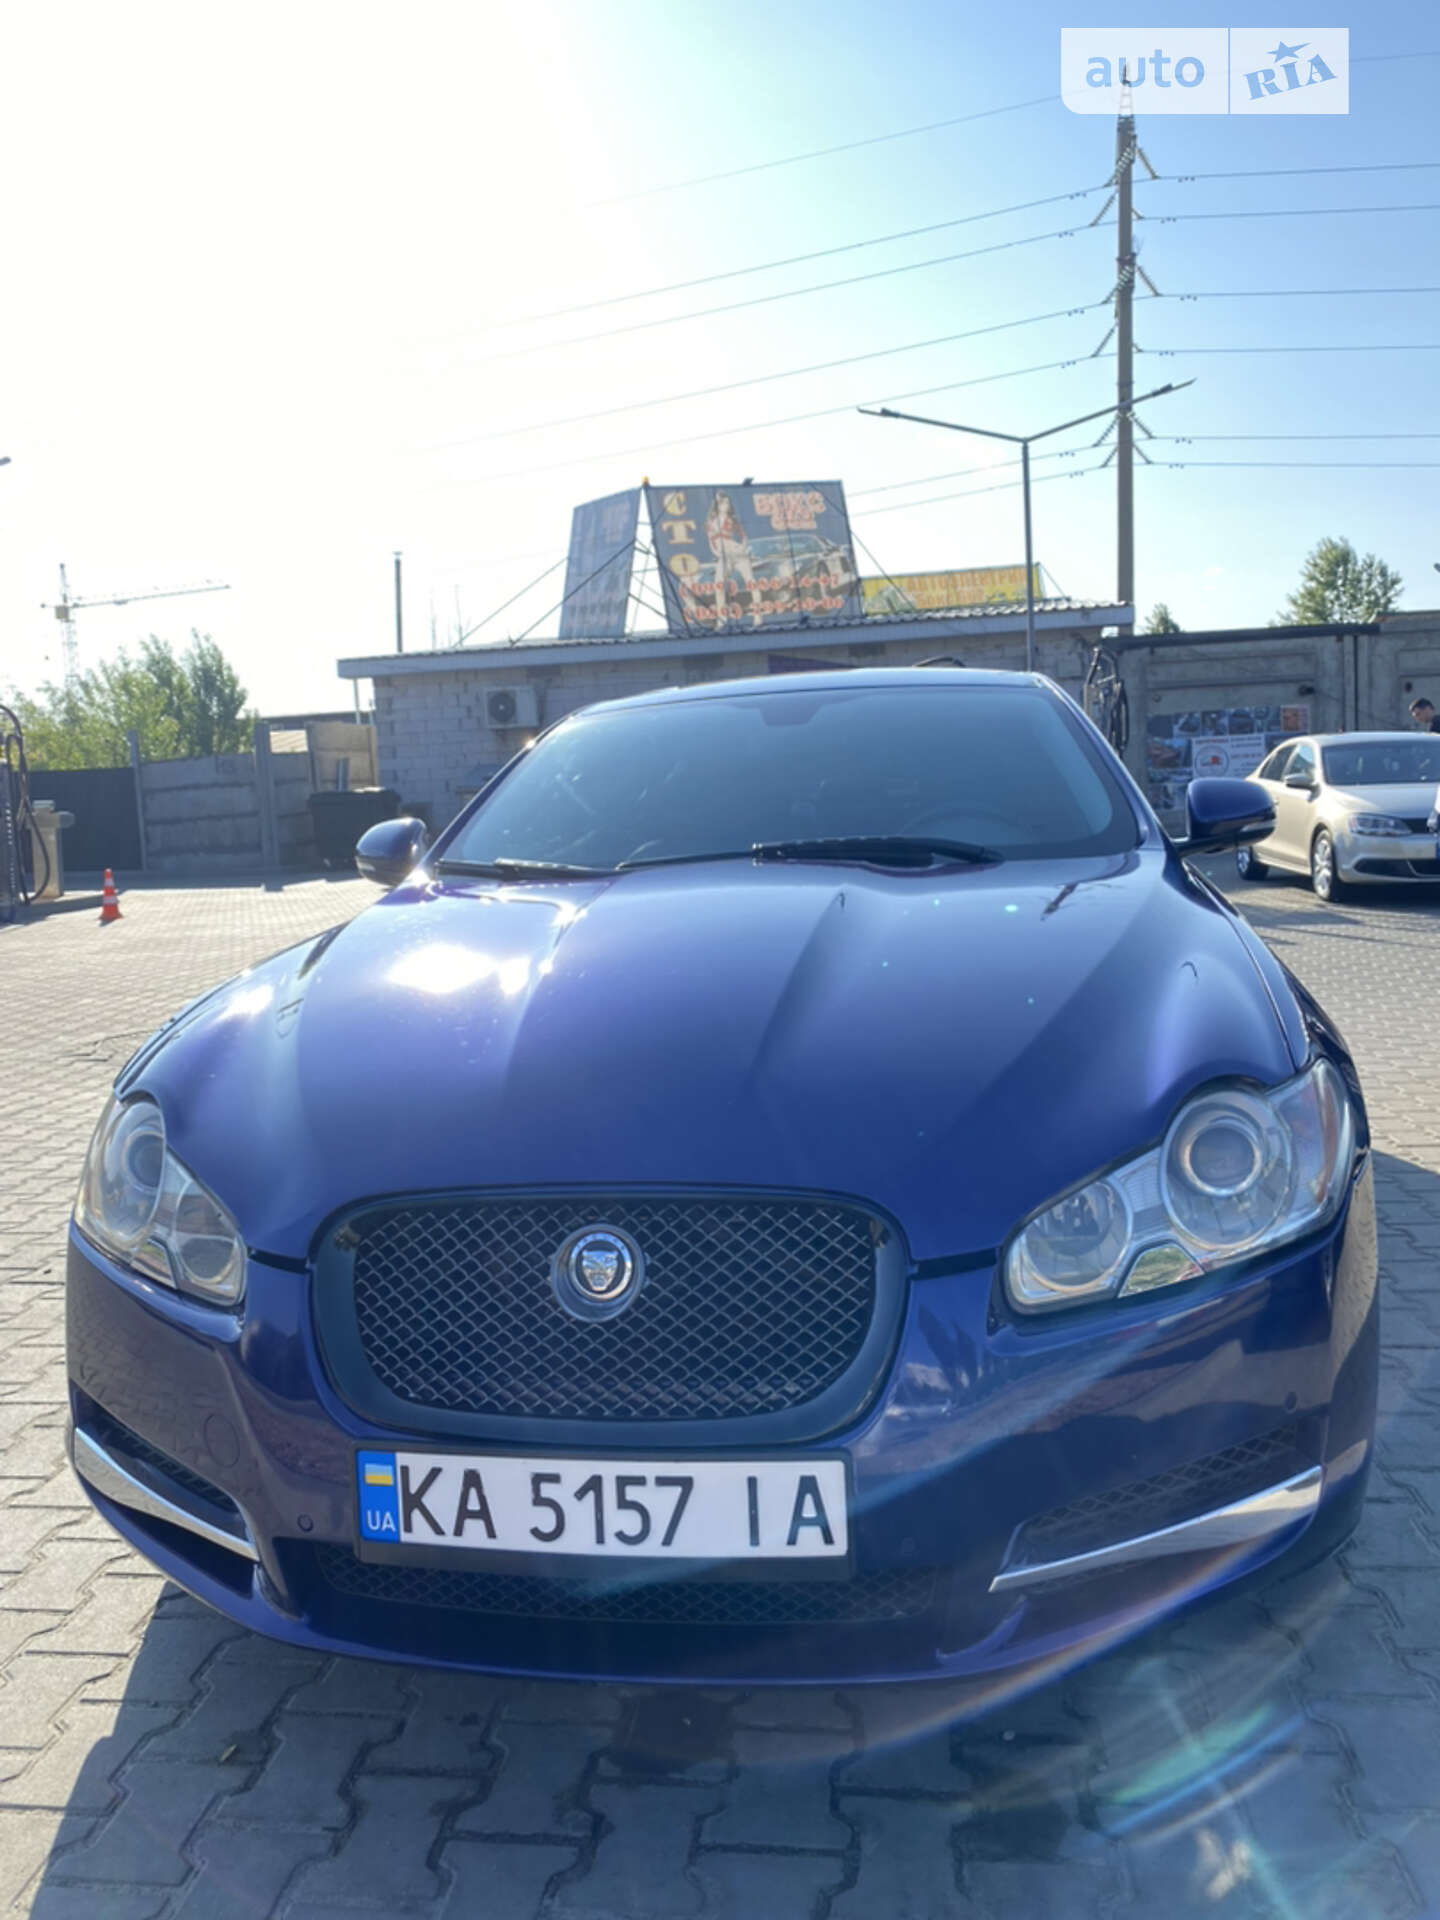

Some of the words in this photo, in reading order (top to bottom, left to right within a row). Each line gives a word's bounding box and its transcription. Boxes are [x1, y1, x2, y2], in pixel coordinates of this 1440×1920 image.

[366, 1510, 396, 1532] UA
[400, 1465, 497, 1539] KA
[529, 1472, 694, 1546] 5157
[747, 1475, 835, 1547] IA
